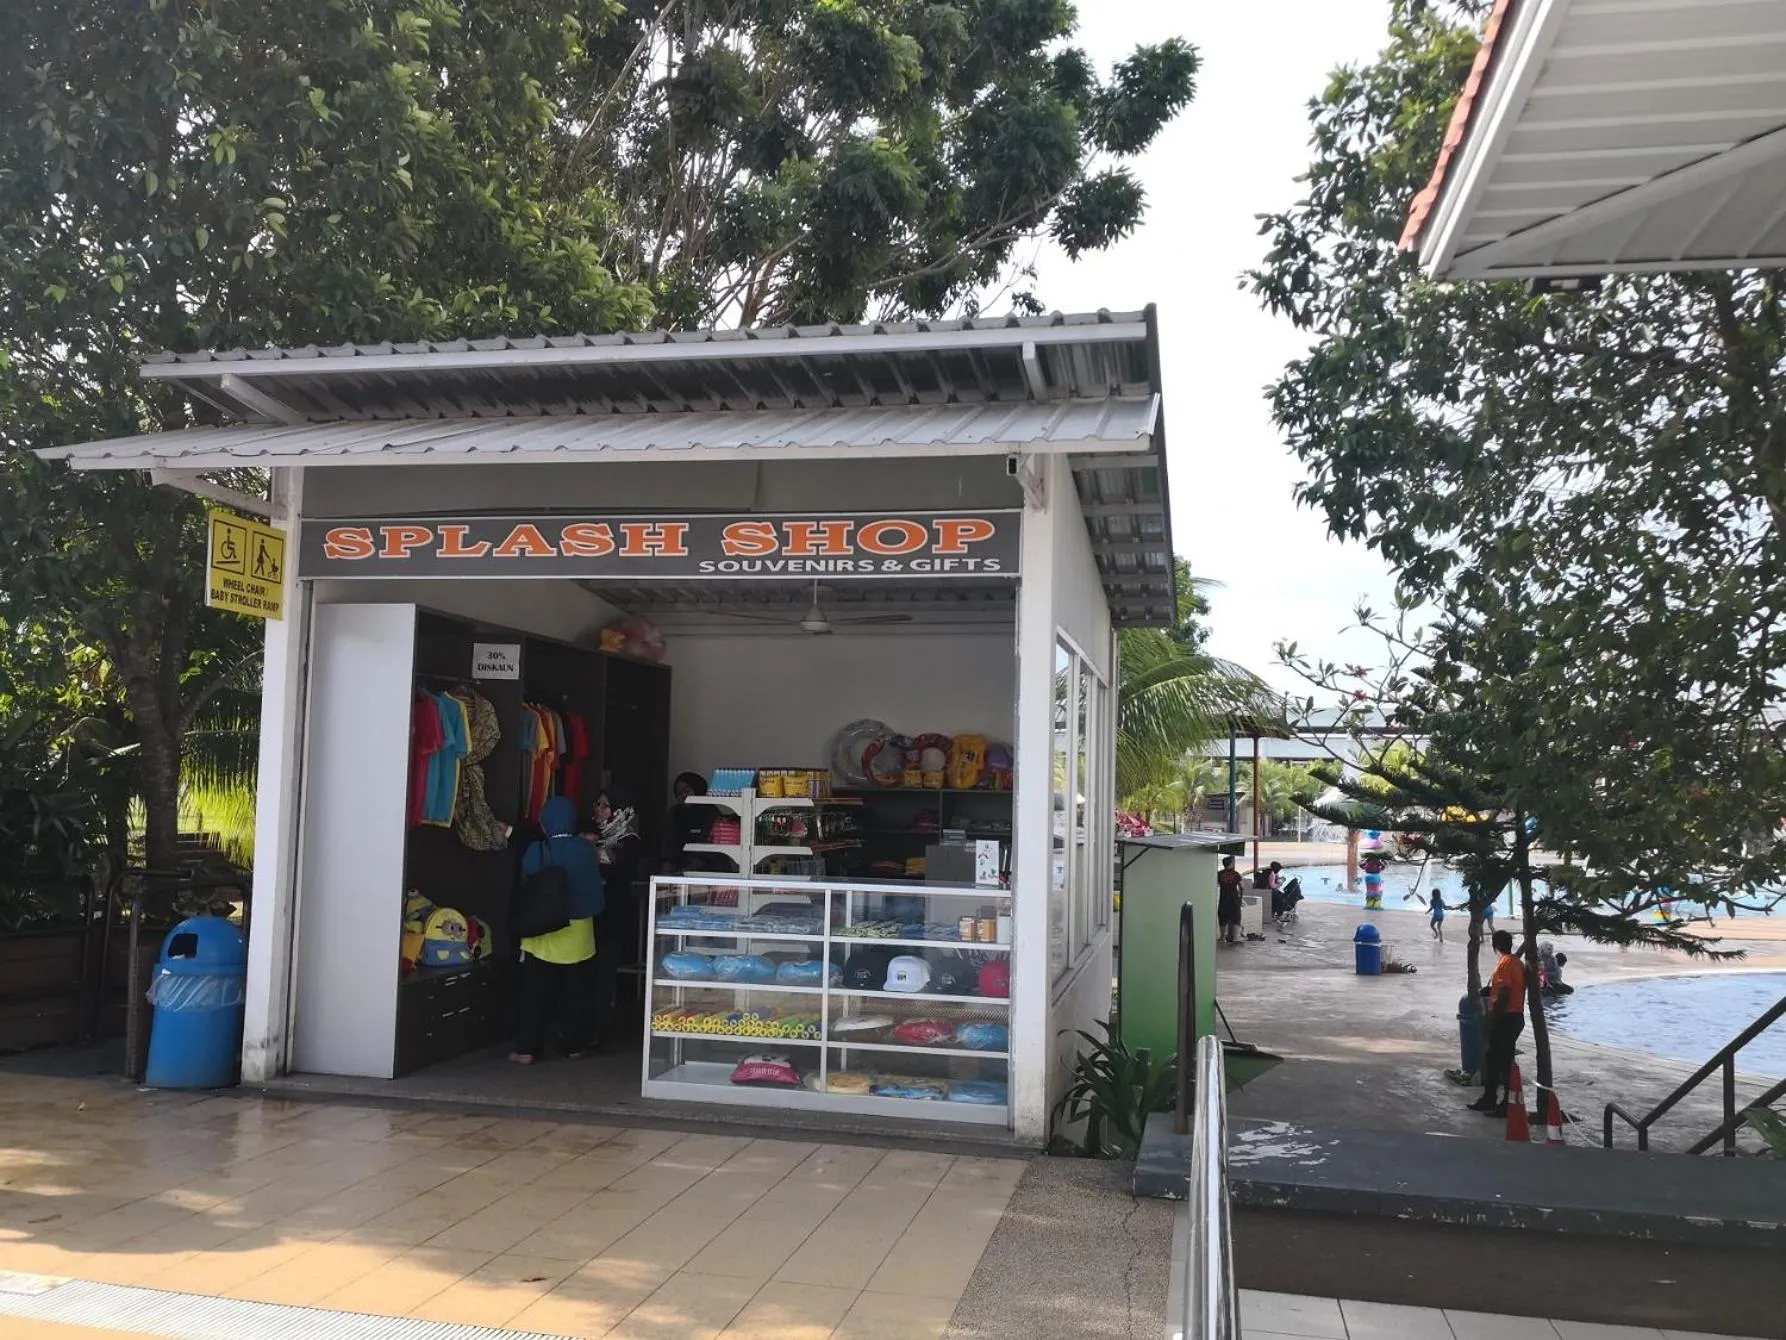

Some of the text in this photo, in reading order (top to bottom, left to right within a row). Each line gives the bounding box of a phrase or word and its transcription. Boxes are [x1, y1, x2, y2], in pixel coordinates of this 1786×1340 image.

[324, 519, 995, 560] SPLASH SHOP
[699, 557, 1001, 573] SOUVENIRS & GIFTS
[223, 578, 244, 592] WHEEL
[211, 589, 280, 612] BABY STROLLER RAMP
